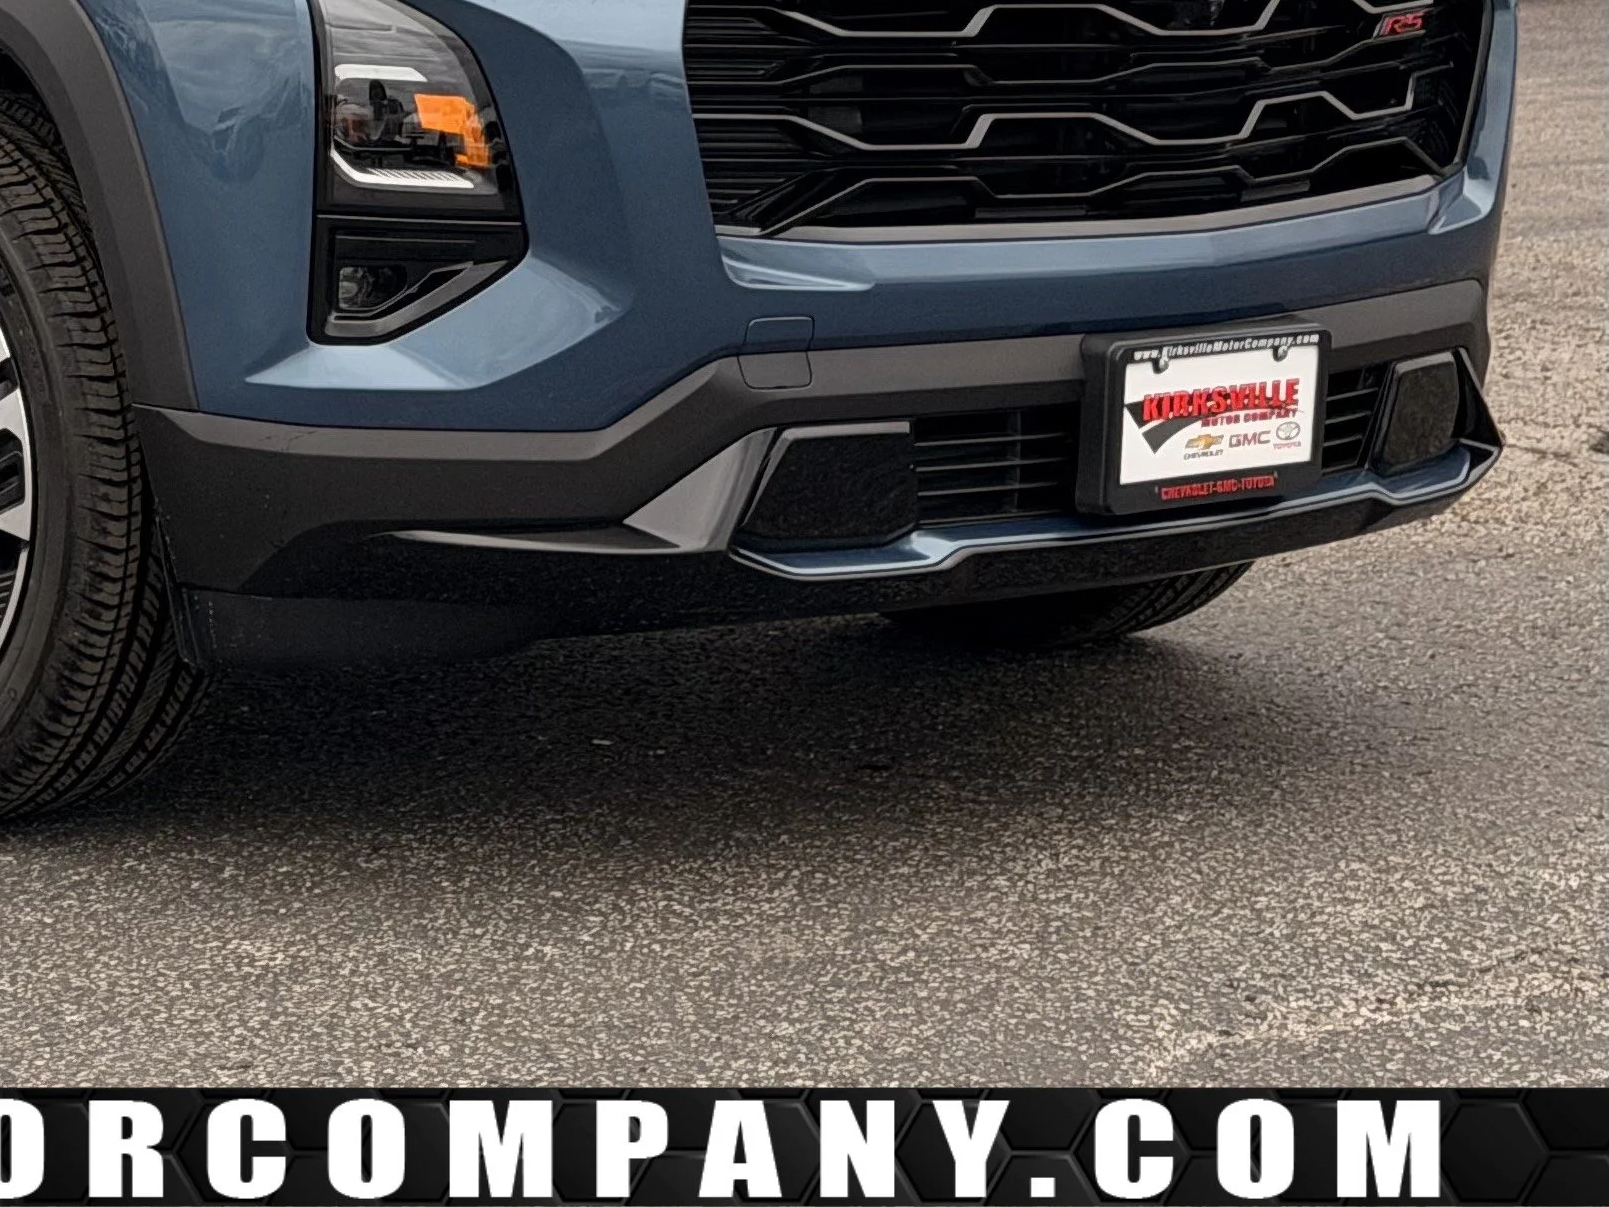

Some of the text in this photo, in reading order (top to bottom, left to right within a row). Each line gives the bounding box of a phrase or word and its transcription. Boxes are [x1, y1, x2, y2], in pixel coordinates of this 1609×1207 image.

[1381, 9, 1426, 36] RS
[1142, 378, 1300, 422] KIRKSVILLE
[1201, 408, 1299, 428] MOTOR COMPANY
[1229, 430, 1271, 448] GMC
